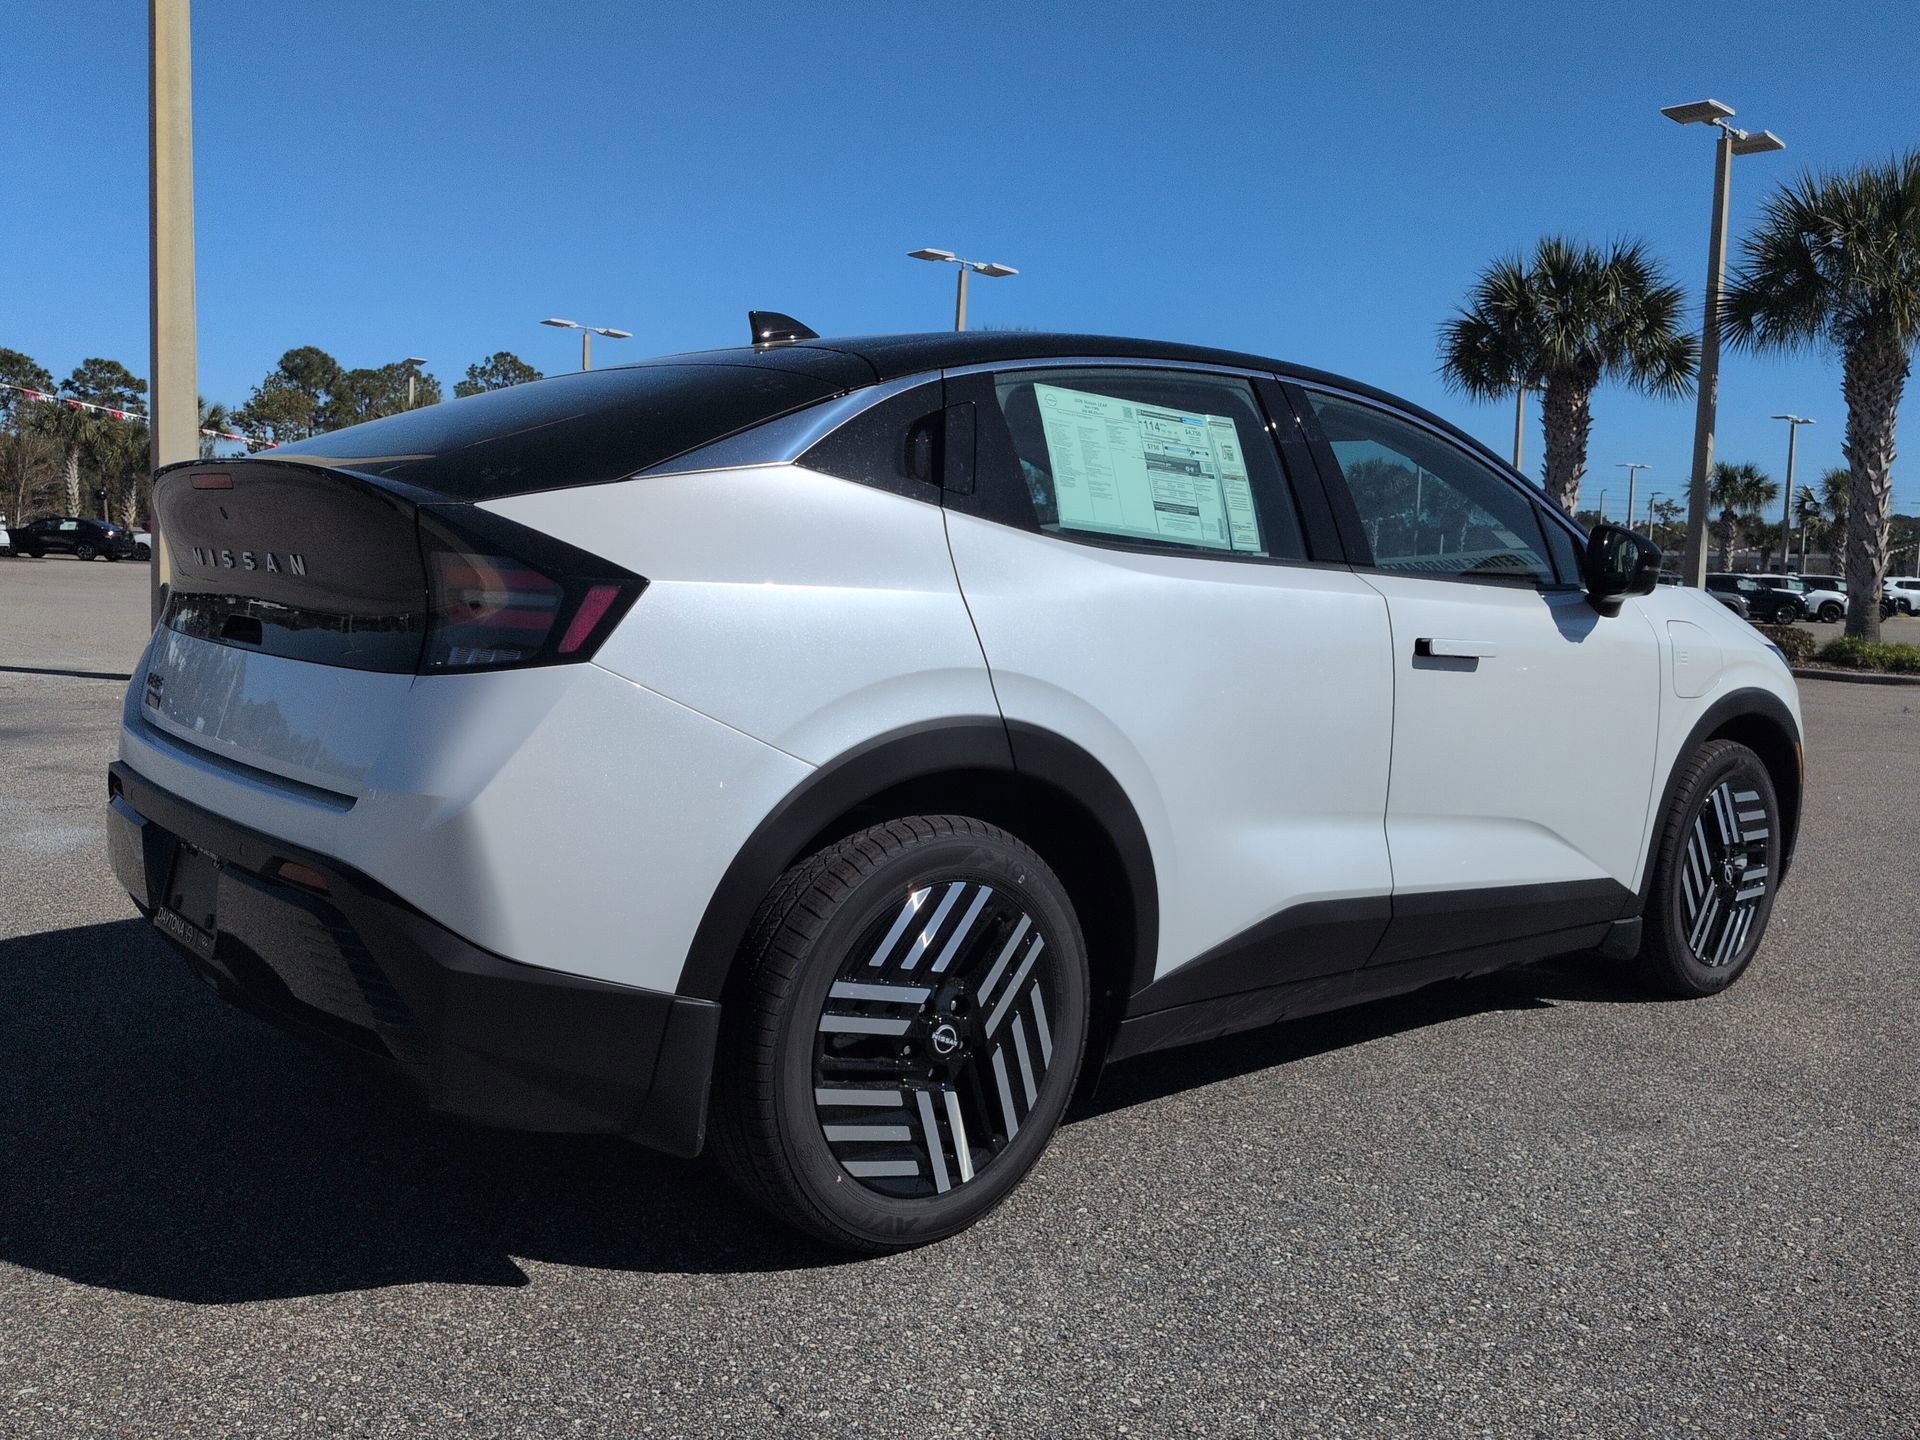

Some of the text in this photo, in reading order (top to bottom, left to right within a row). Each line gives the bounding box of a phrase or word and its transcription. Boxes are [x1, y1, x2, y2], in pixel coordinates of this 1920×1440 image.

[1143, 420, 1161, 432] 114
[192, 546, 307, 576] NISSAN
[158, 907, 185, 937] DAYTONA
[932, 1032, 959, 1047] NISSAN
